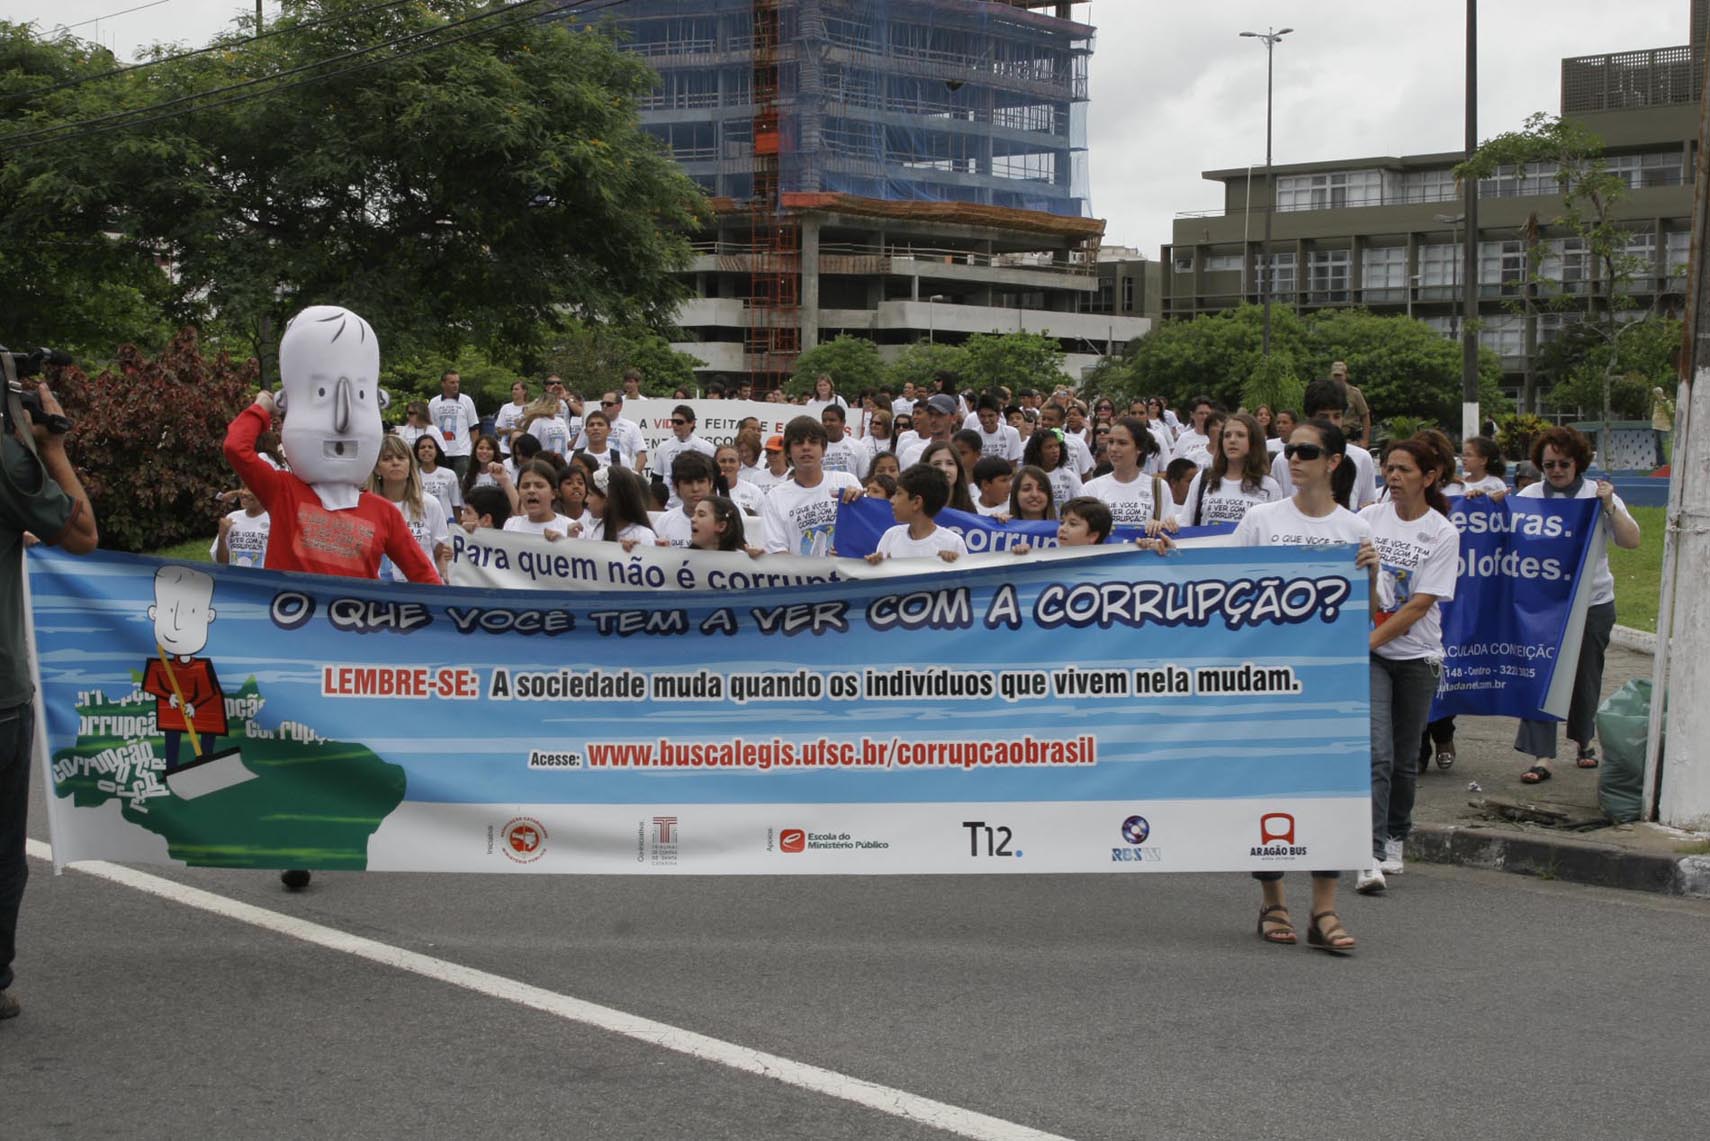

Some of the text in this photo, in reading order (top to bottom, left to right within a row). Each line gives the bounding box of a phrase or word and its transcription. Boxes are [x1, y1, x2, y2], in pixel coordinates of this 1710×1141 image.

[654, 419, 675, 429] VID
[453, 535, 511, 570] Para
[518, 551, 599, 581] quem
[608, 556, 666, 588] não
[676, 560, 696, 590] é
[273, 591, 312, 627] O
[329, 600, 429, 630] QUE
[594, 610, 684, 632] TEM
[701, 607, 735, 632] A
[752, 602, 846, 632] VER
[870, 587, 971, 625] COM
[987, 583, 1020, 624] A
[1037, 578, 1349, 629] CORRUPÇÃO?
[324, 666, 1300, 703] LEMBRE-SE: A sociedade muda quando os indivíduos que vivem nela mudam.
[530, 738, 1096, 771] Acesse: www.buscalegis.ufsc.br/corrupcaobrasil
[808, 833, 851, 841] Escola do
[808, 841, 889, 850] Ministério Público
[1290, 847, 1308, 856] BUS
